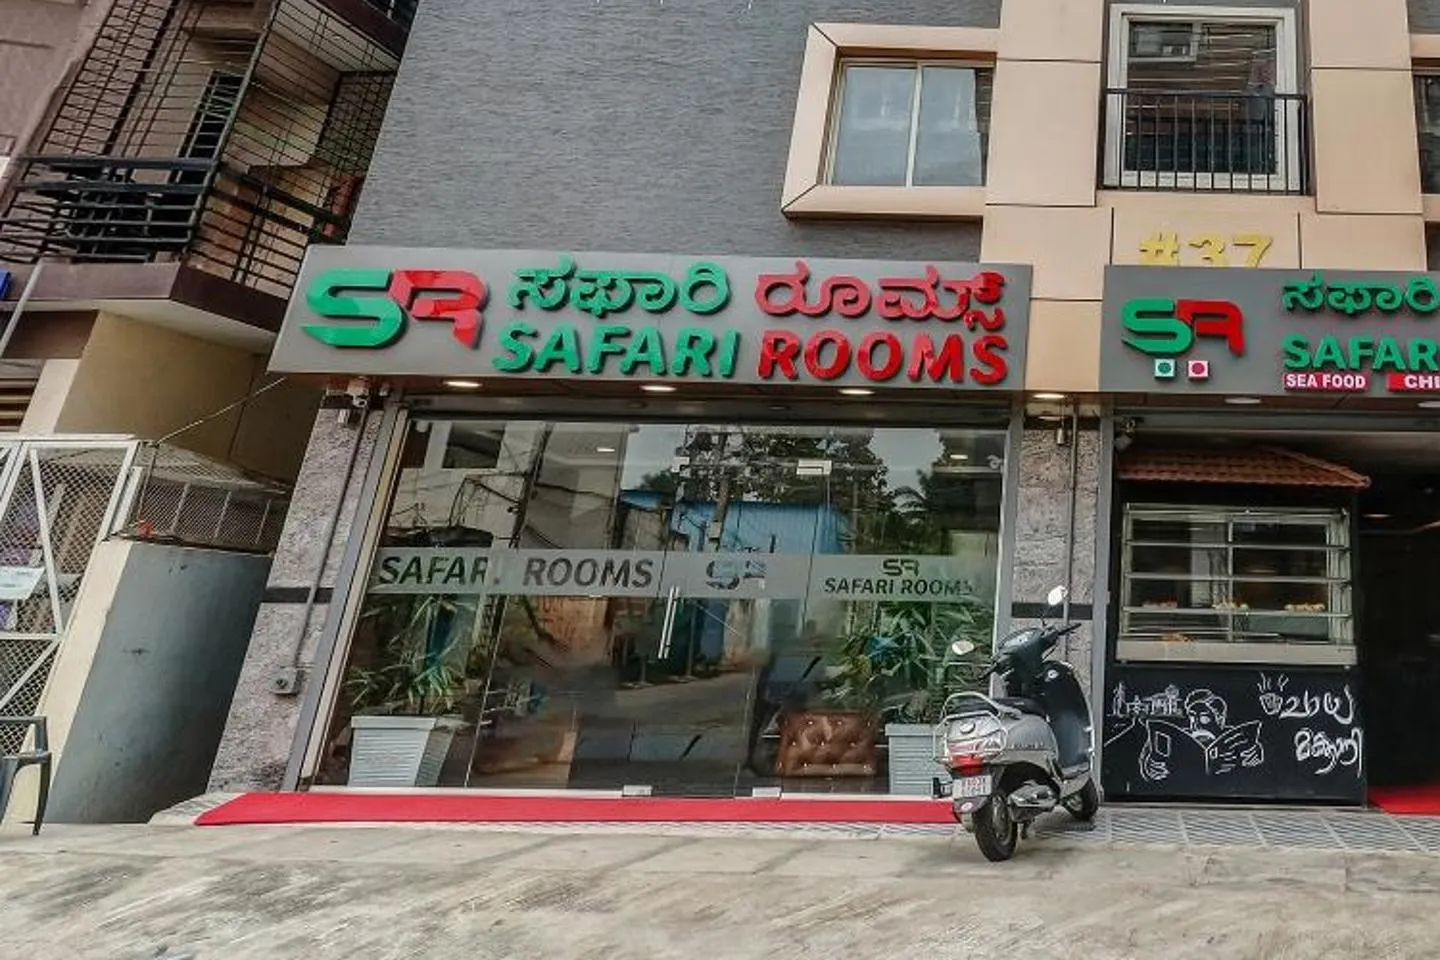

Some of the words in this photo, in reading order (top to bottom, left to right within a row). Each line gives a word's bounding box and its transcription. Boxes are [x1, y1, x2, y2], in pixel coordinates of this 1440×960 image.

[492, 322, 739, 378] SAFARI
[756, 329, 1010, 385] ROOMS
[1285, 373, 1320, 390] SEA
[1322, 374, 1367, 391] FOOD
[378, 554, 501, 587] SAFAR
[522, 556, 655, 589] ROOMS
[823, 577, 895, 595] SAFARI
[901, 578, 974, 597] ROOMS
